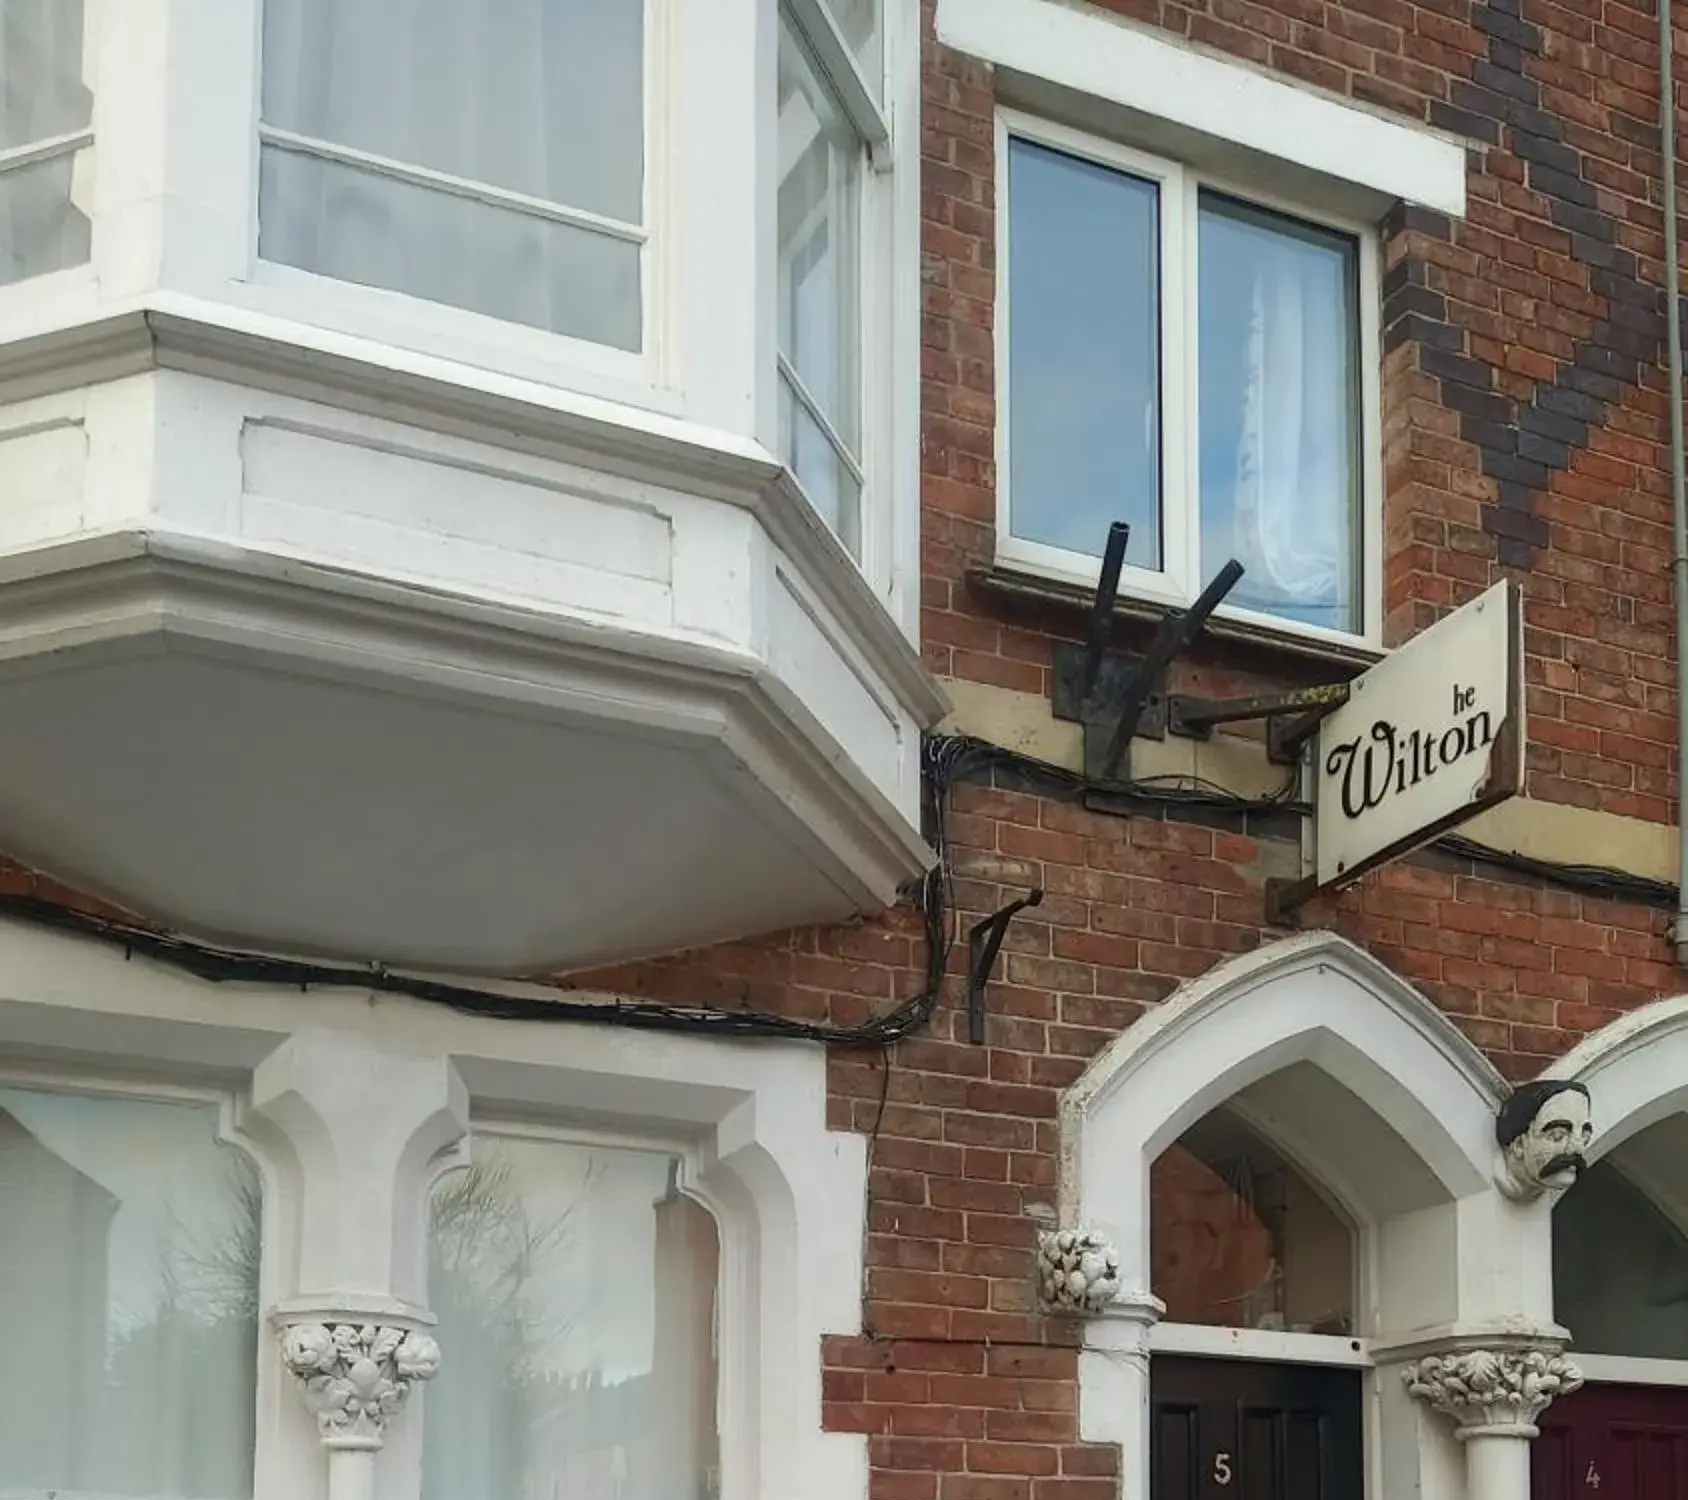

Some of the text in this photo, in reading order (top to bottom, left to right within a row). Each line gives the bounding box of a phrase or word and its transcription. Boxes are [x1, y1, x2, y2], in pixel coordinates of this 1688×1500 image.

[1326, 710, 1496, 820] Wilton
[1214, 1453, 1231, 1485] 5
[1585, 1460, 1601, 1489] 4
